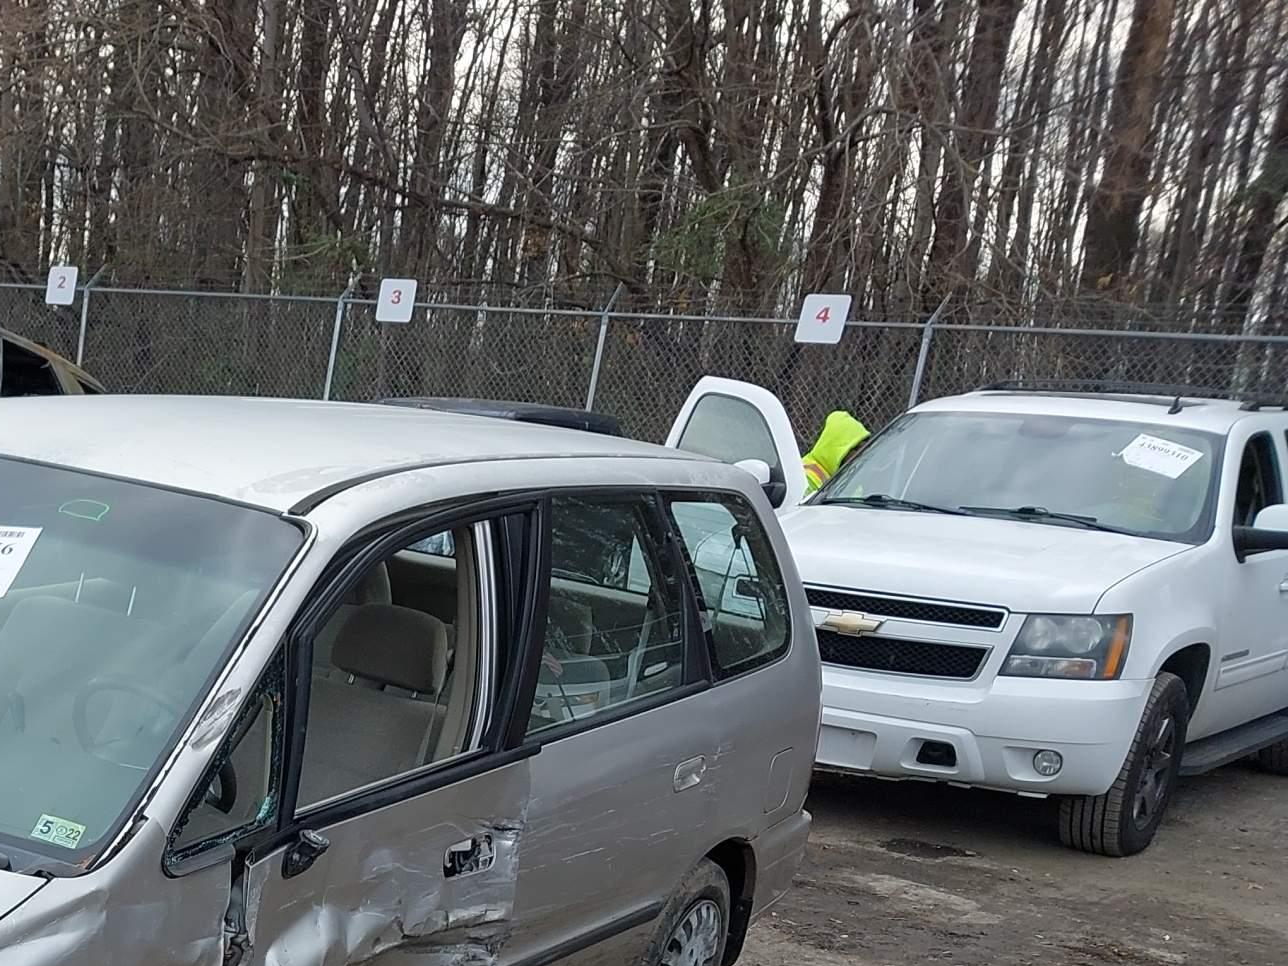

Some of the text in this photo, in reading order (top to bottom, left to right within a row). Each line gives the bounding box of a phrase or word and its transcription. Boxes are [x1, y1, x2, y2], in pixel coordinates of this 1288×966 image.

[57, 275, 66, 289] 2
[391, 289, 402, 305] 3
[815, 306, 831, 323] 4
[39, 820, 54, 835] 5
[65, 828, 81, 841] 22
